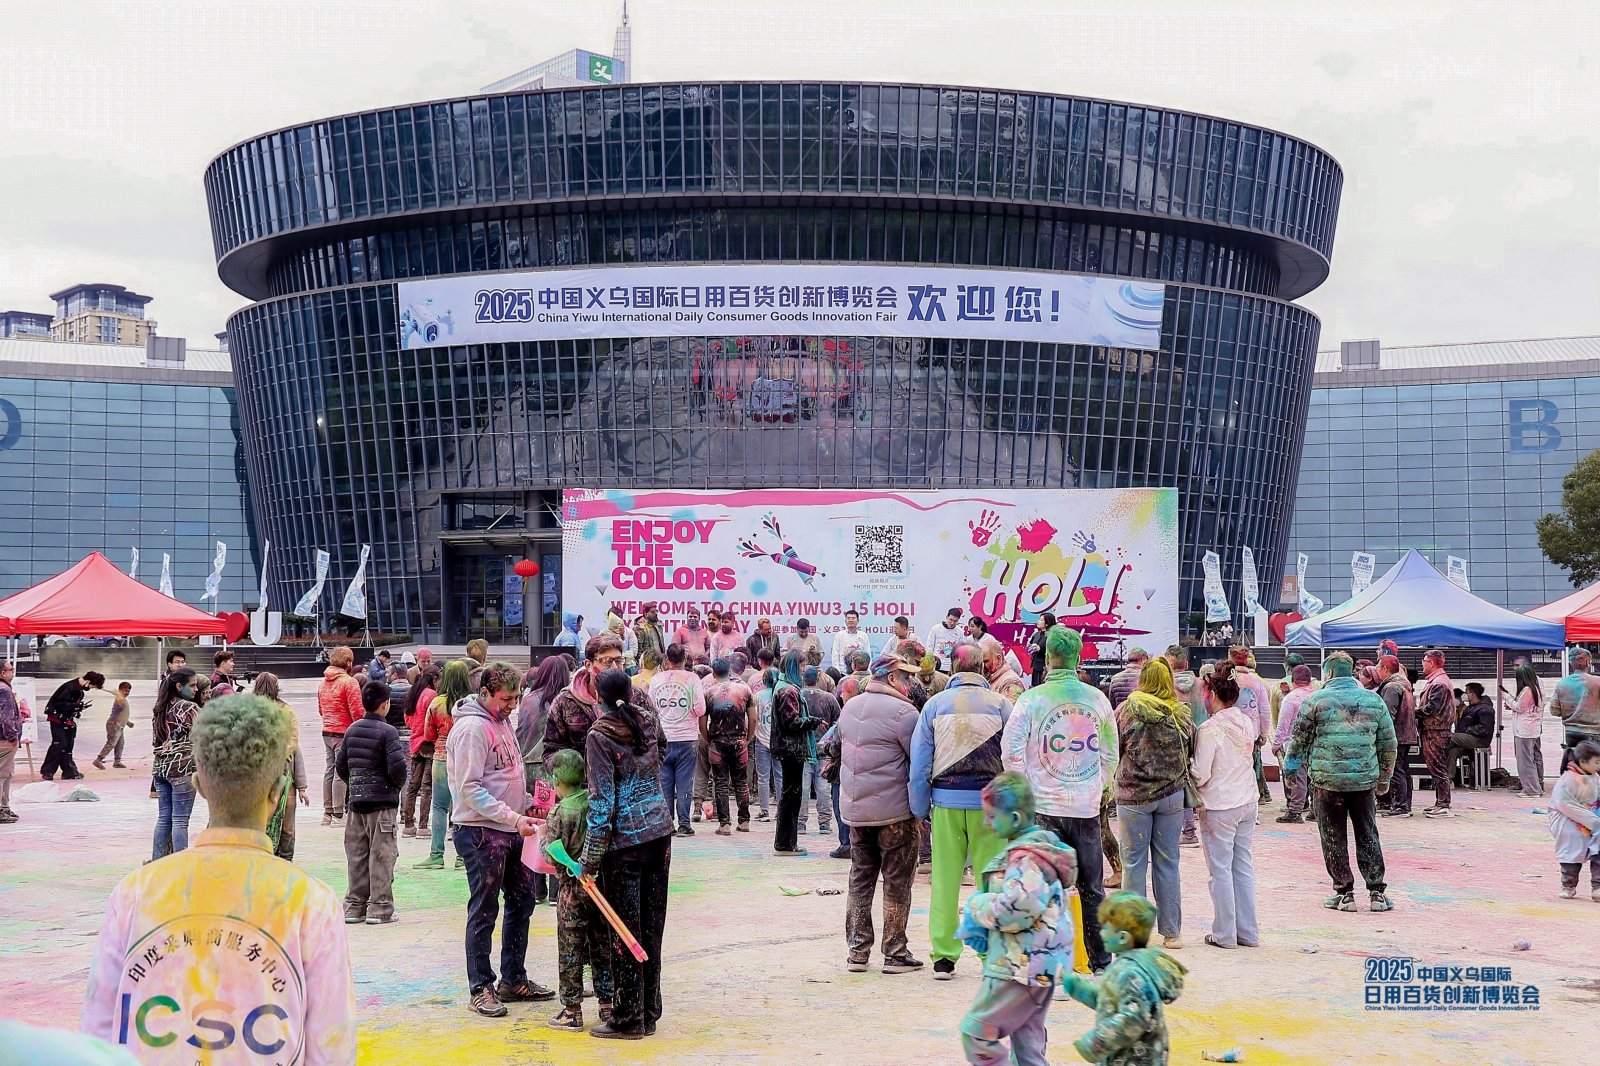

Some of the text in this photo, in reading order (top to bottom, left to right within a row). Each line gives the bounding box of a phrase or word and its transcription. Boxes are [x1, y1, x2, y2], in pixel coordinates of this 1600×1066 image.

[475, 289, 534, 323] 2025
[538, 285, 897, 310] 中国义乌国际日用百货创新博览会
[538, 311, 898, 323] China Yiwu International Daily Consumer Goods Innovation Fair
[1509, 399, 1562, 454] B
[612, 520, 717, 543] ENJOY
[611, 544, 673, 567] THE
[611, 567, 737, 590] COLORS
[701, 601, 724, 615] TO
[729, 601, 784, 616] CHINA
[874, 602, 915, 616] HOLI
[250, 611, 283, 646] U
[1043, 733, 1099, 754] ICSC
[119, 993, 289, 1056] ICSC
